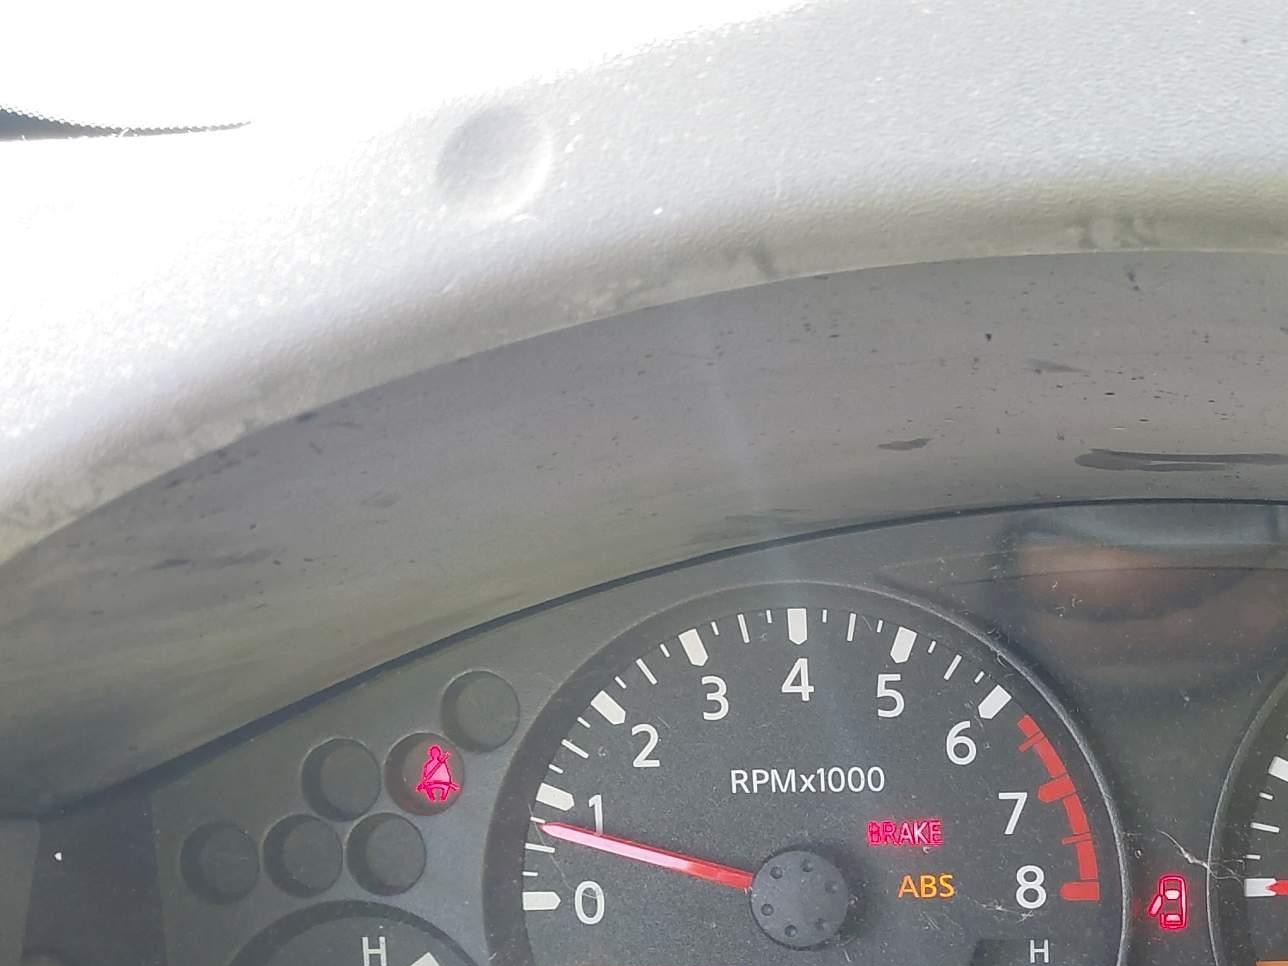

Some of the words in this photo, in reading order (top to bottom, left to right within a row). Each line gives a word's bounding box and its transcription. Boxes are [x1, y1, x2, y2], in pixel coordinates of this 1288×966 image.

[701, 675, 729, 721] 3
[781, 657, 815, 702] 4
[876, 673, 905, 718] 5
[631, 723, 661, 768] 2
[946, 720, 977, 765] 6
[730, 766, 885, 794] RPMx1000
[588, 794, 604, 833] 1
[867, 820, 943, 846] BRAKE
[998, 791, 1028, 835] 7
[574, 880, 605, 925] 0
[898, 874, 955, 898] ABS
[1015, 865, 1047, 909] 8
[1029, 939, 1050, 964] H
